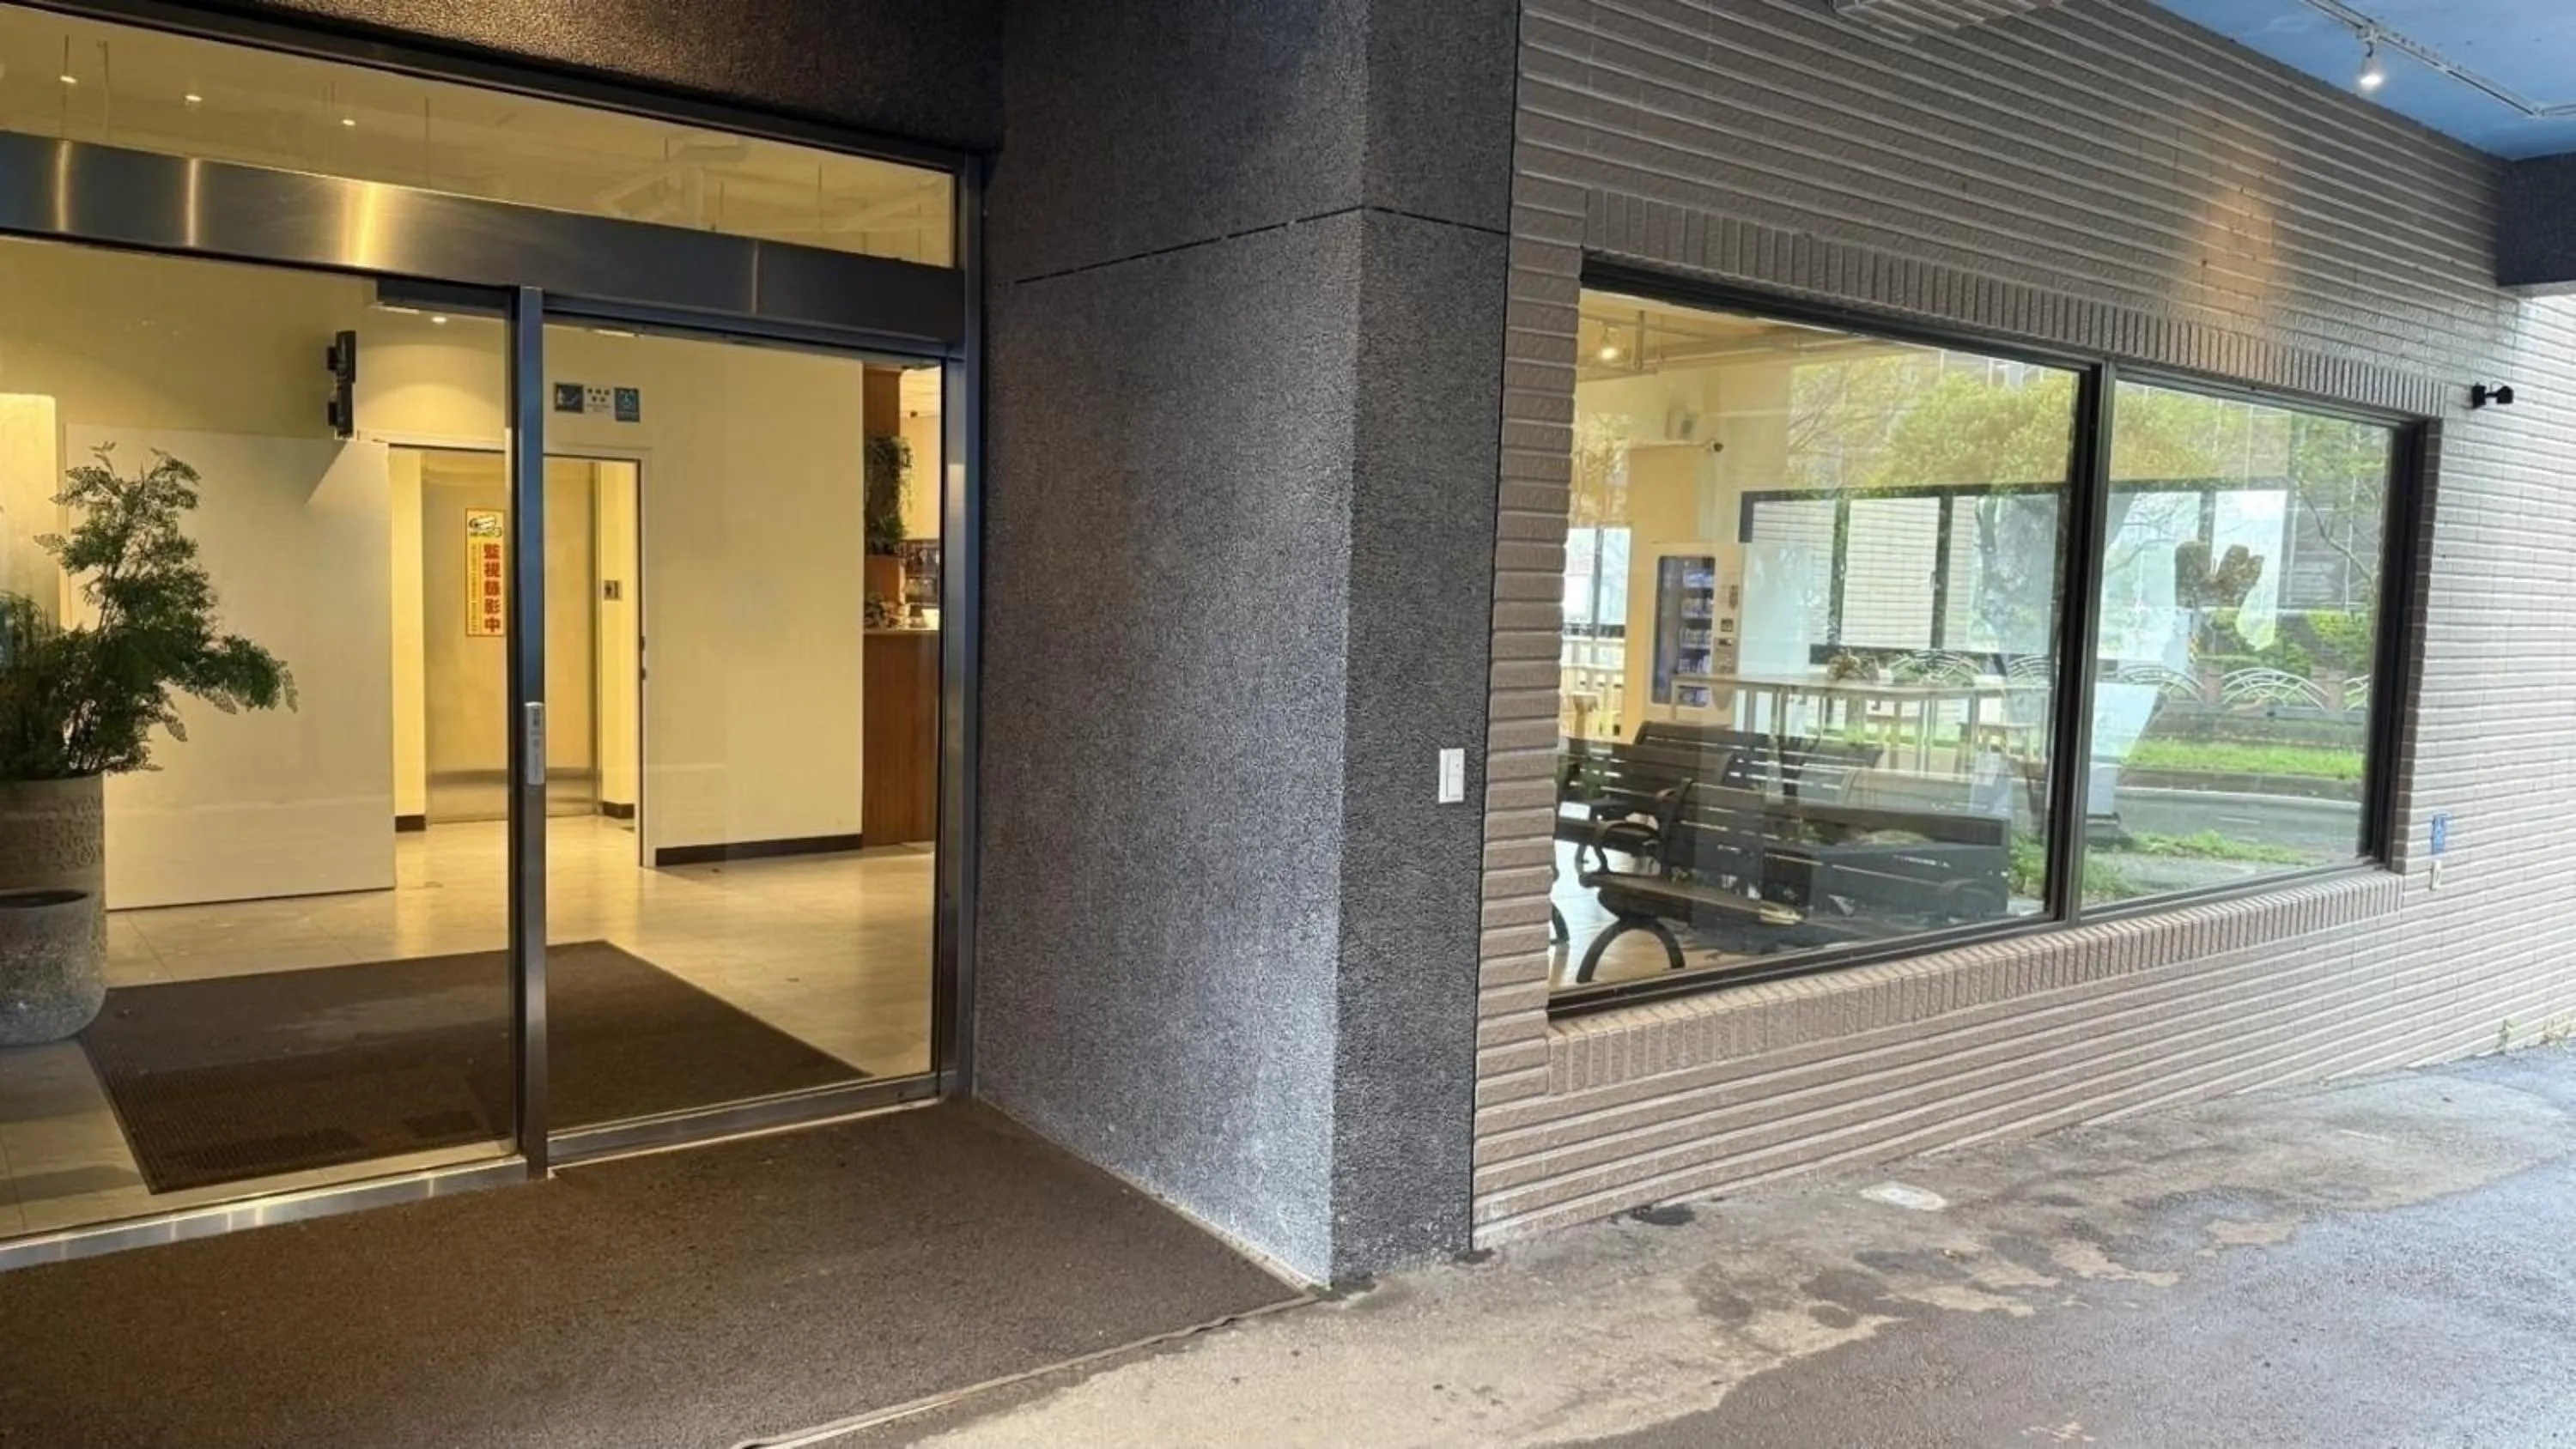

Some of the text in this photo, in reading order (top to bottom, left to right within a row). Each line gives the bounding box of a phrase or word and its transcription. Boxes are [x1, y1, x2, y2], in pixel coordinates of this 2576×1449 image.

[483, 543, 501, 633] 監視錄影中
